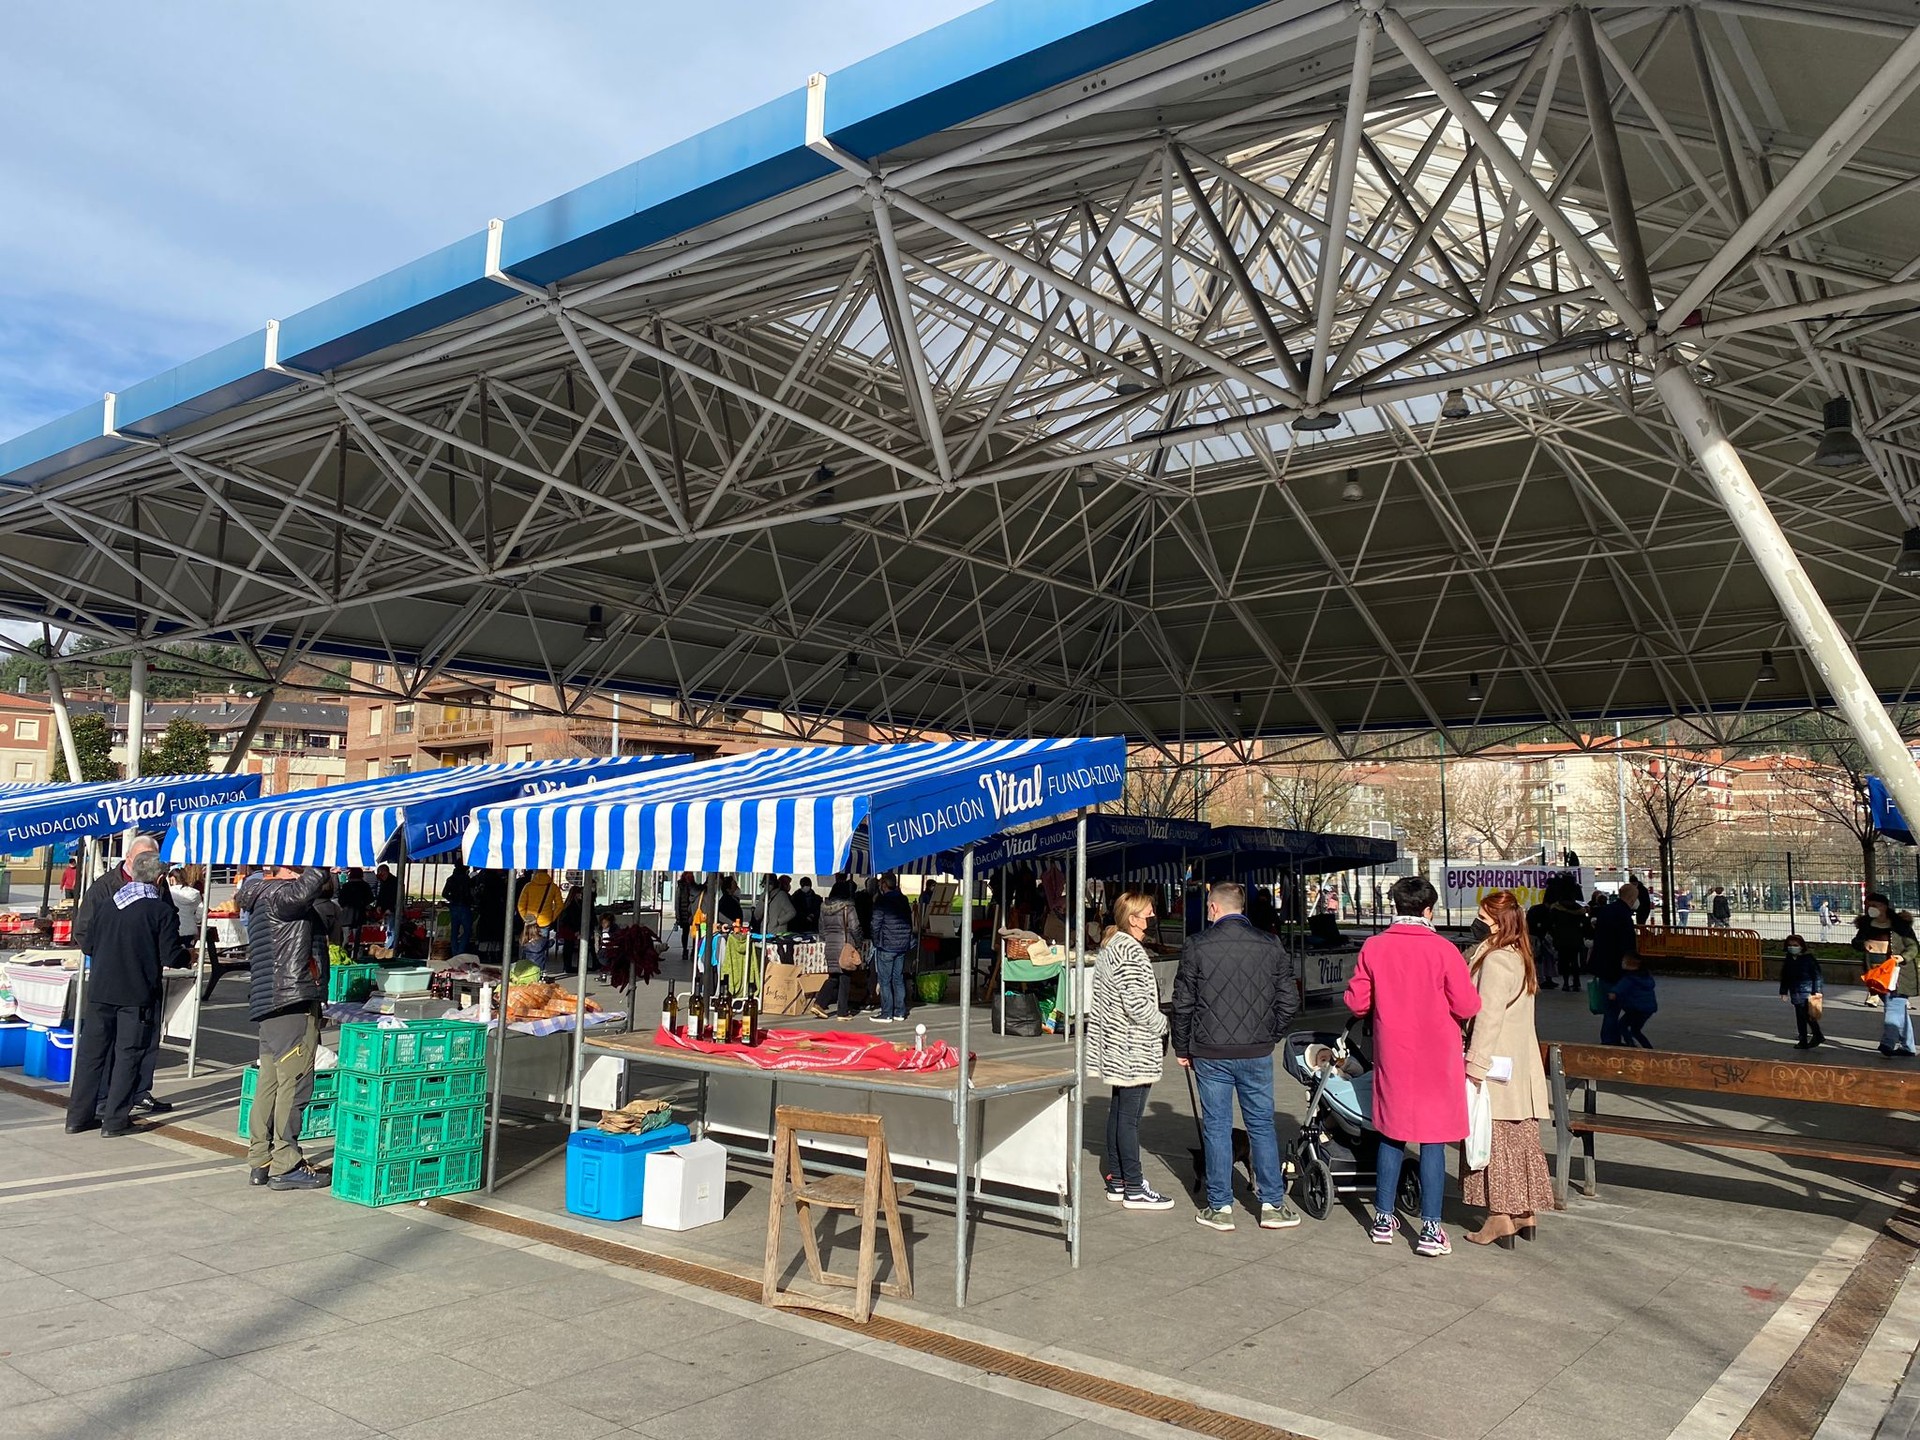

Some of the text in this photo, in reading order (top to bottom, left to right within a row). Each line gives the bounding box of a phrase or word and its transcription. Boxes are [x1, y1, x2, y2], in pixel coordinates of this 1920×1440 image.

[7, 812, 100, 842] FUNDACIÓN
[97, 791, 165, 826] Vital
[886, 763, 1123, 848] FUNDACIÓN Vital FUNDAZIOA
[1002, 833, 1038, 858] Vital
[1039, 829, 1078, 847] FUNDAZIO
[1145, 819, 1170, 840] Vital
[1317, 957, 1344, 985] Vital
